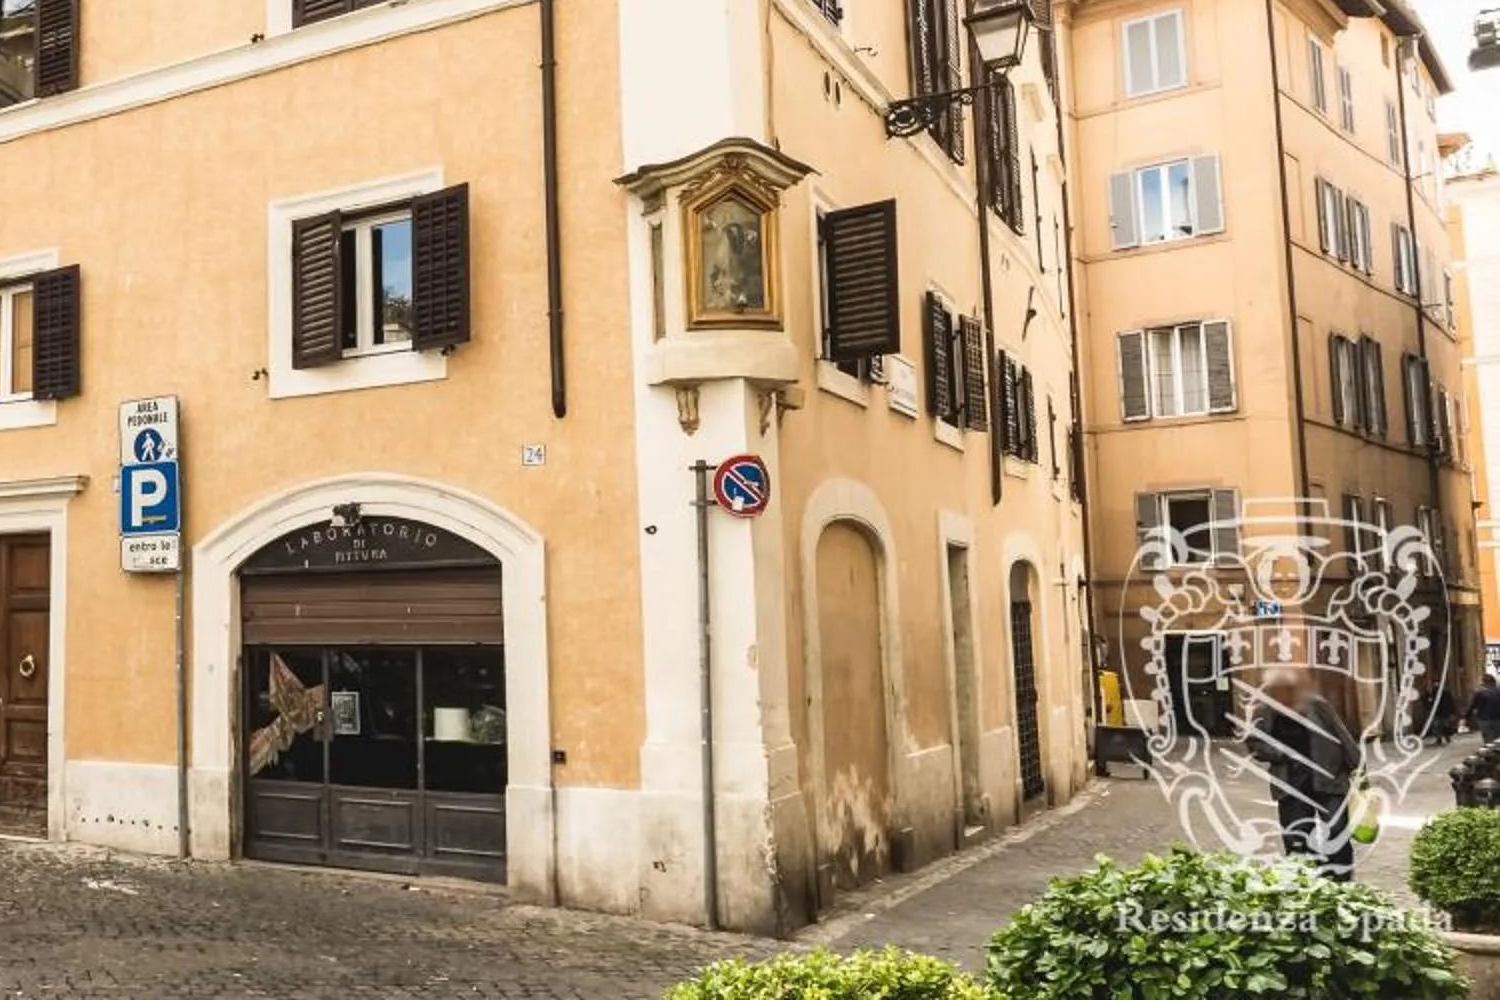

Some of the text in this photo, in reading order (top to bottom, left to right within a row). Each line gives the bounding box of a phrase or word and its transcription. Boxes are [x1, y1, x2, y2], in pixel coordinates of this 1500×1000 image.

[132, 469, 167, 526] P
[285, 523, 437, 554] LABORATORIO
[353, 539, 365, 549] DI
